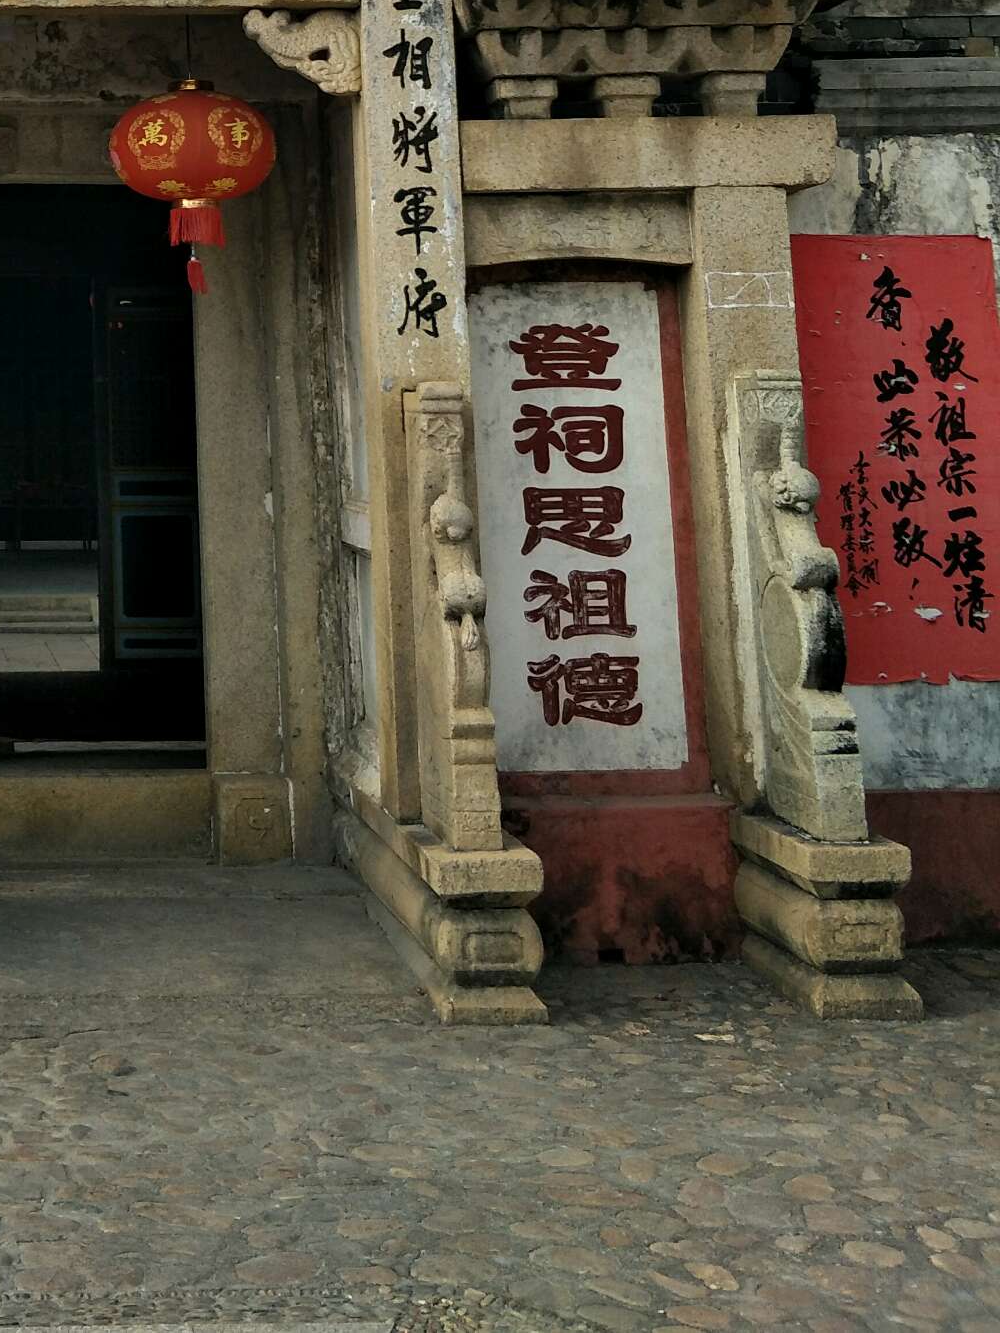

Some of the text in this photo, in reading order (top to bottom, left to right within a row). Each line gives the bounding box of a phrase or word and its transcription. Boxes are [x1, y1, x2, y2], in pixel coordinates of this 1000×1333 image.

[138, 118, 250, 149] 萬 事
[509, 322, 645, 727] 登祠思祖德
